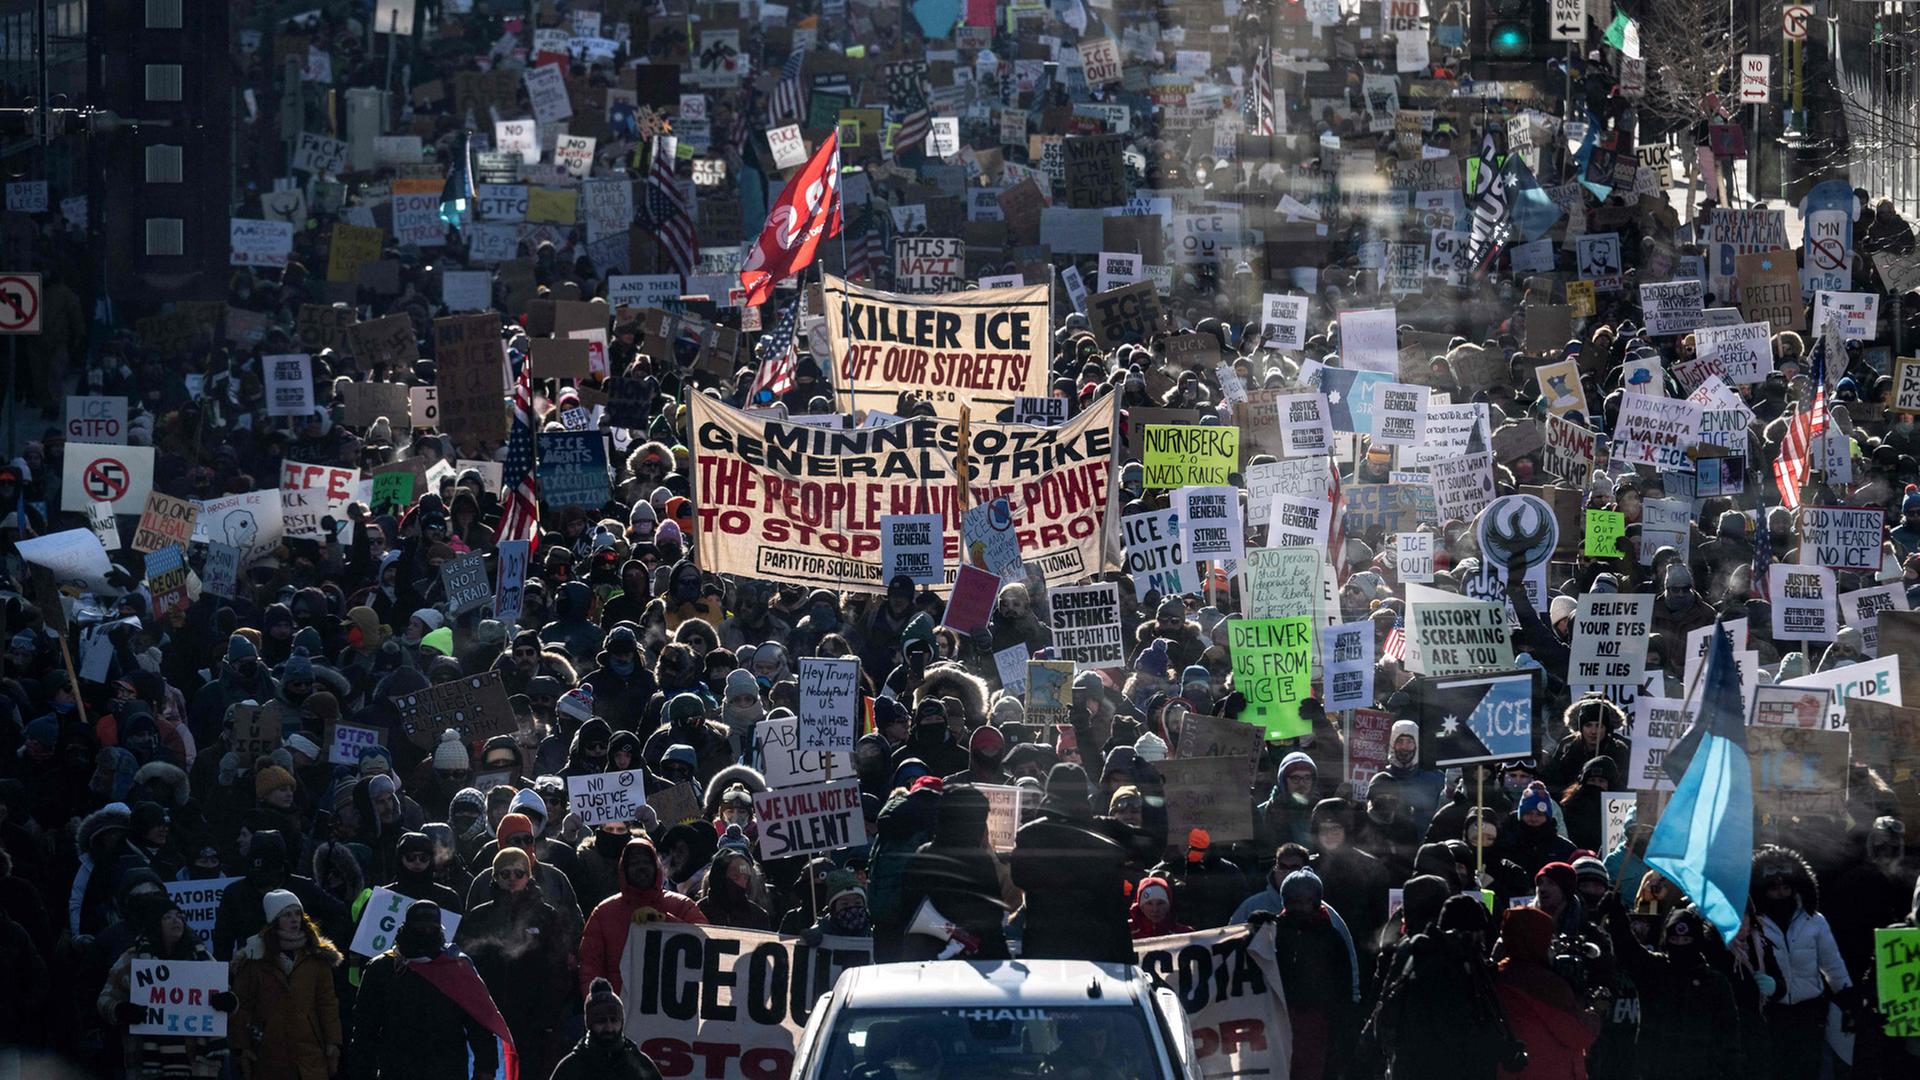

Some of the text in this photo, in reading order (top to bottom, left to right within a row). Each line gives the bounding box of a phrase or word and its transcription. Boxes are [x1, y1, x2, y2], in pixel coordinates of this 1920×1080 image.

[1391, 2, 1418, 17] NO
[1557, 0, 1581, 10] ONE
[1556, 11, 1580, 21] WAY
[1084, 48, 1112, 63] ICE
[1087, 64, 1117, 80] OUT!
[1749, 61, 1762, 71] NO
[568, 139, 586, 148] NO
[770, 127, 798, 144] FUCK
[1637, 148, 1669, 165] FUCK
[492, 187, 519, 196] ICE
[1714, 226, 1748, 243] GREAT
[1817, 222, 1840, 236] MN
[897, 239, 945, 258] THIS
[900, 258, 956, 275] NAZI
[1107, 266, 1133, 276] GENERAL
[648, 280, 678, 290] THEN
[1746, 283, 1791, 302] PRETTI
[1095, 289, 1159, 319] ICE
[1271, 310, 1299, 320] GENERAL
[1750, 307, 1793, 326] GOOD
[841, 301, 1030, 350] KILLER ICE
[1697, 325, 1769, 345] IMMIGRANTS
[1717, 342, 1745, 354] MAKE
[841, 344, 1032, 392] OFF OUR STREETS!
[1385, 391, 1419, 401] EXPAND THE
[80, 401, 113, 418] ICE
[1021, 400, 1063, 416] KILLER
[1289, 400, 1318, 412] JUSTICE
[1384, 400, 1417, 412] GENERAL
[69, 419, 120, 437] GTFO
[1625, 415, 1690, 435] HORCHATA
[554, 437, 586, 450] ICE
[764, 420, 1058, 455] MINNESOTA
[1550, 416, 1594, 460] SHAME
[1630, 428, 1678, 447] WARM
[543, 449, 592, 463] AGENTS
[699, 421, 1111, 482] GENERAL STRIKE
[1179, 454, 1198, 464] 2.0
[1658, 448, 1688, 467] ICE
[555, 464, 584, 475] ARE
[1251, 459, 1324, 482] SILENCE
[1466, 456, 1488, 471] WHAT
[285, 464, 352, 500] ICE
[1145, 464, 1184, 485] NAZIS
[1448, 473, 1477, 489] SOUNDS
[375, 477, 403, 490] FUCK
[698, 455, 884, 531] THE PEOPLE
[1189, 495, 1226, 506] EXPAND THE
[1445, 488, 1483, 503] LIKE WHEN
[170, 503, 196, 522] ONE
[207, 495, 261, 514] ABOLISH ICE
[1189, 505, 1227, 520] GENERAL
[1283, 503, 1320, 518] EXPAND THE
[141, 512, 187, 539] ILLEGAL
[1282, 513, 1318, 530] GENERAL
[1592, 513, 1616, 524] ICE
[1801, 510, 1881, 529] COLD WINTERS
[698, 508, 881, 557] TO STOP
[892, 522, 931, 533] EXPAND THE
[1126, 517, 1162, 546] ICE
[1194, 528, 1227, 541] STRIKE!
[1593, 525, 1614, 534] OUT
[893, 532, 932, 546] GENERAL
[1282, 533, 1314, 546] STRIKE!
[1402, 537, 1426, 551] ICE
[1802, 529, 1880, 547] WARM HEARTS
[445, 556, 480, 575] WE ARE
[764, 552, 824, 574] PARTY FOR
[896, 553, 929, 567] STRIKE!
[1131, 545, 1170, 573] OUT
[1816, 548, 1870, 566] NO ICE
[451, 570, 478, 588] NOT
[1149, 569, 1183, 597] MN
[1785, 573, 1820, 586] JUSTICE
[1052, 589, 1117, 610] GENERAL
[1784, 586, 1823, 599] FOR ALEX
[1857, 592, 1892, 609] JUSTICE
[1422, 607, 1501, 626] HISTORY IS
[1591, 602, 1639, 616] BELIEVE
[1857, 608, 1876, 620] FOR
[1053, 607, 1119, 629] STRIKE:
[1784, 616, 1825, 625] KILLED BY CBP
[1055, 626, 1120, 647] THE PATH TO
[1235, 622, 1309, 648] DELIVER
[1422, 628, 1505, 645] SCREAMING
[1580, 622, 1645, 636] YOUR EYES
[1335, 631, 1361, 648] JUSTICE
[1597, 641, 1621, 655] NOT
[1057, 644, 1122, 663] JUSTICE
[1432, 648, 1497, 664] ARE YOU
[1237, 650, 1308, 676] US FROM
[1579, 663, 1630, 677] THE LIES
[802, 664, 855, 685] Hey Trump
[1244, 676, 1296, 704] ICE
[401, 693, 476, 718] PRIVILEGE
[819, 699, 834, 709] US
[802, 715, 816, 726] We
[1355, 715, 1375, 729] SALT
[1486, 701, 1531, 736] ICE
[1650, 709, 1677, 722] EXPAND
[337, 728, 373, 744] GTFO
[829, 736, 852, 746] FREE
[787, 748, 839, 775] ICE
[588, 778, 604, 793] NO
[575, 790, 629, 808] JUSTICE
[756, 787, 860, 822] WE WILL NOT BE
[596, 804, 636, 821] PEACE
[766, 812, 852, 856] SILENT
[136, 965, 170, 987] NO
[641, 930, 739, 1021] ICE
